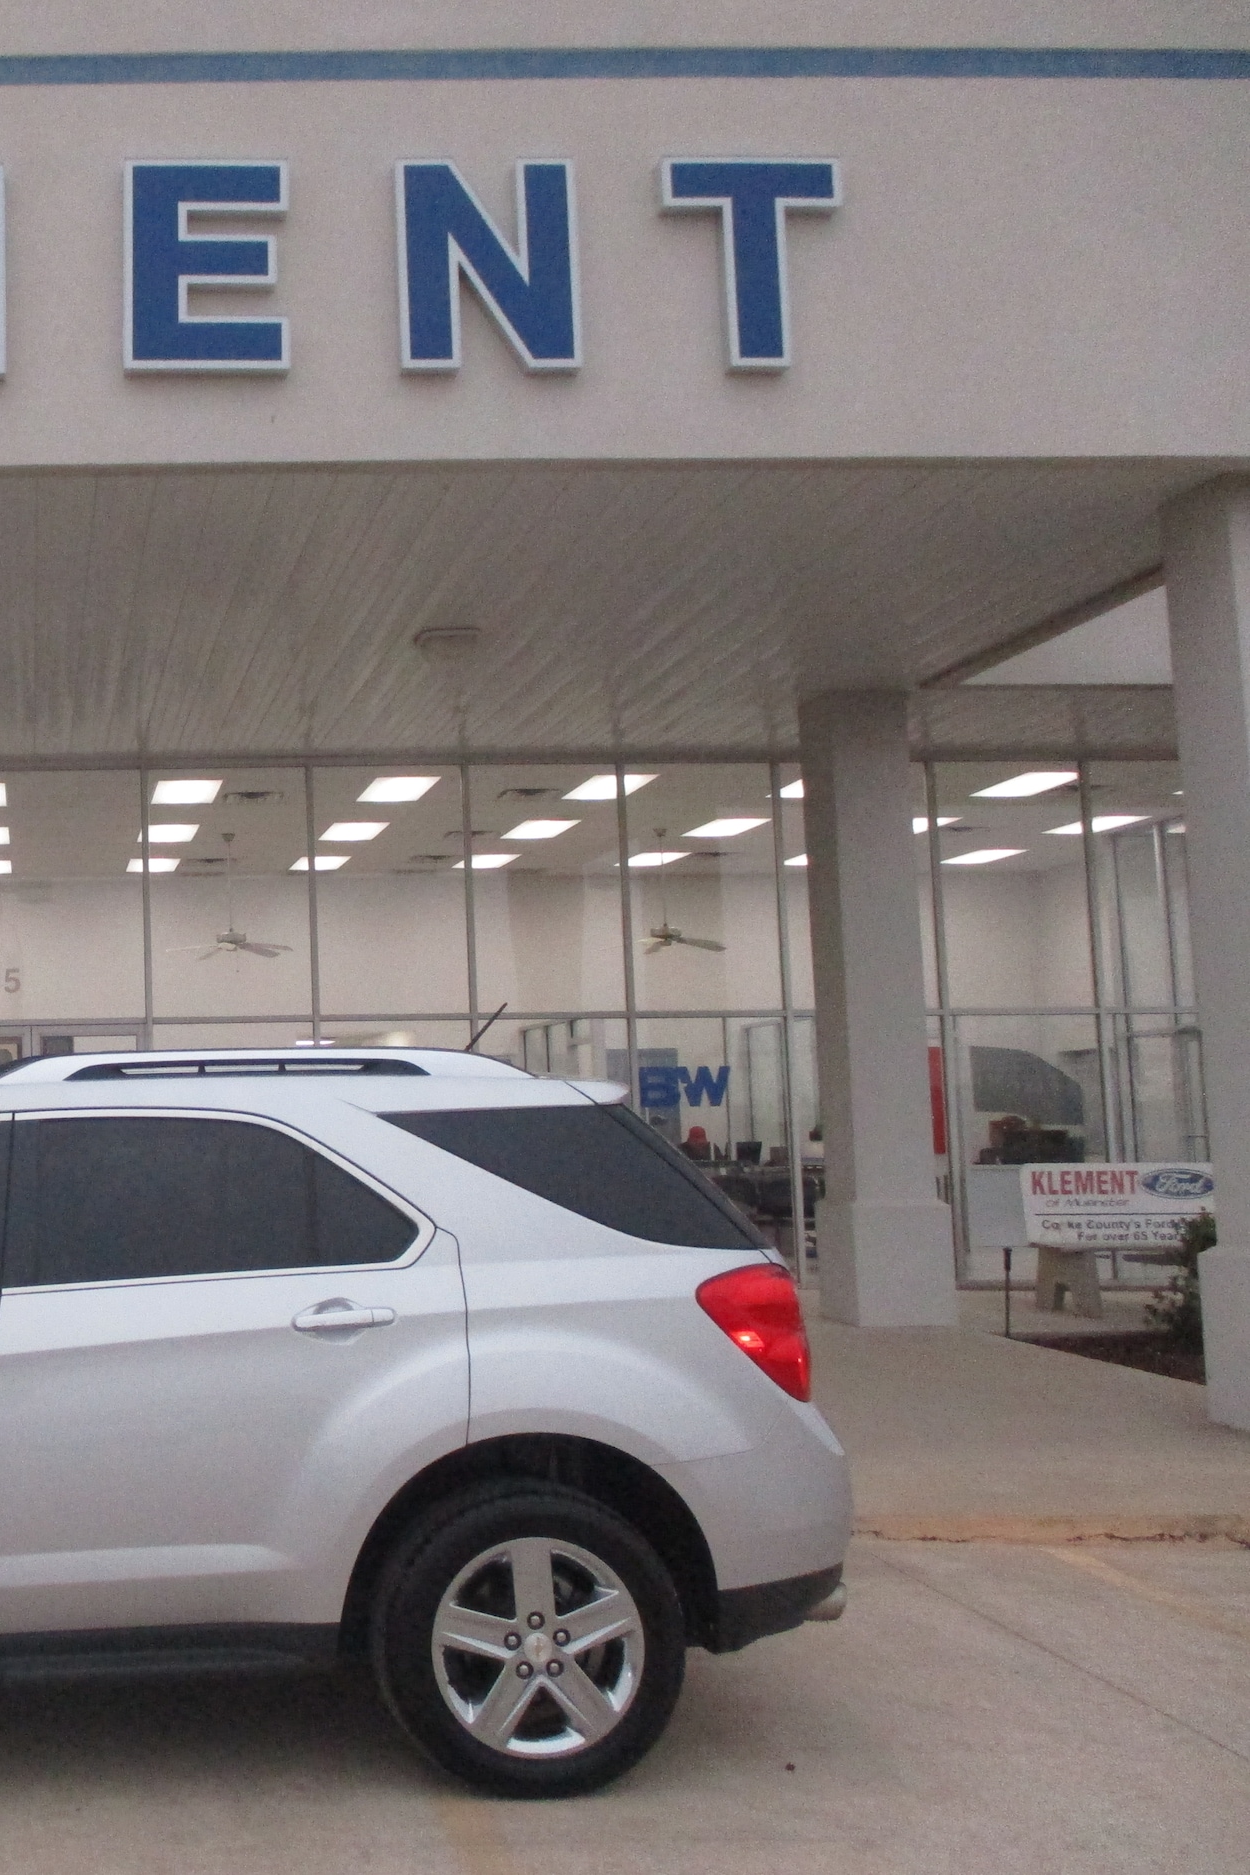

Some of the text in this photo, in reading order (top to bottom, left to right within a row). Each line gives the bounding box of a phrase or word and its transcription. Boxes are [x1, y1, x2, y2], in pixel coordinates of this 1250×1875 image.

[1031, 1170, 1138, 1195] KLEMENT
[1156, 1173, 1204, 1194] Ford
[1086, 1218, 1142, 1233] County's
[1103, 1232, 1130, 1241] over
[1152, 1231, 1179, 1241] Year
